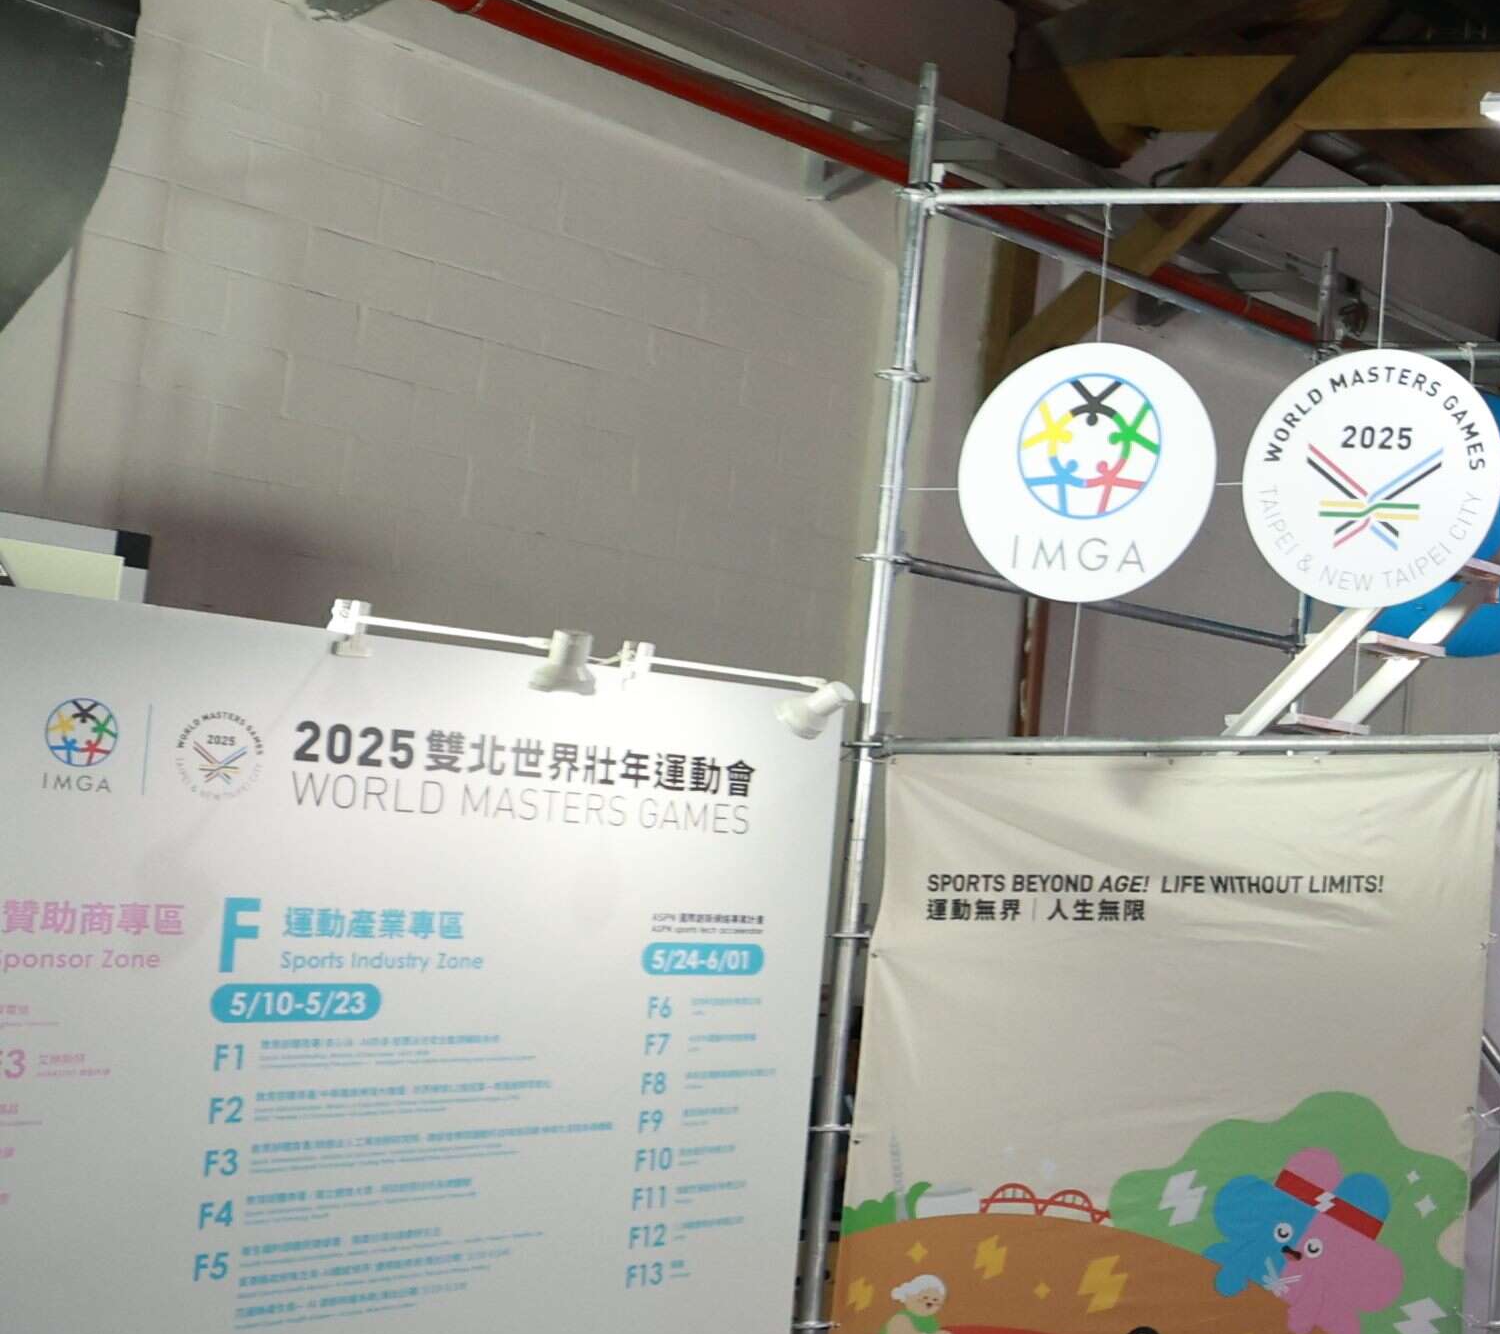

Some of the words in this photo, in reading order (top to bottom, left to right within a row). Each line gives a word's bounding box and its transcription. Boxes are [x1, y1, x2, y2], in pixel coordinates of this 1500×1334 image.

[1264, 387, 1324, 464] WORLD
[1329, 366, 1442, 399] MASTERS
[1442, 393, 1488, 472] GAMES
[1341, 425, 1413, 451] 2025
[1257, 484, 1297, 558] TAIPEI
[1318, 564, 1373, 592] NEW
[1380, 540, 1453, 591] TAIPEI
[1450, 491, 1481, 542] CITY
[1011, 536, 1147, 574] IMGA
[207, 734, 236, 746] 2025
[41, 772, 111, 793] IMGA
[291, 770, 445, 815] WORLD
[460, 783, 627, 828] MASTERS
[639, 797, 750, 835] GAMES
[927, 874, 1006, 893] SPORTS
[1012, 874, 1094, 893] BEYOND
[1098, 875, 1149, 893] AGE!
[1160, 875, 1205, 894] LIFE
[1210, 875, 1303, 894] WITHOUT
[1308, 875, 1385, 894] LIMITS!
[219, 897, 261, 973] F
[282, 907, 465, 940] 運動產業專區
[102, 950, 160, 969] Zone
[280, 952, 344, 971] Sports
[351, 953, 429, 974] Industry
[437, 953, 484, 970] Zone
[652, 949, 750, 972] 5/24-6/01
[229, 991, 367, 1020] 5/10-5/23
[648, 996, 672, 1019] F6
[213, 1044, 245, 1071] F1
[645, 1033, 671, 1056] F7
[0, 1049, 26, 1079] 3
[641, 1071, 667, 1095] F8
[208, 1097, 244, 1124] F2
[638, 1110, 664, 1133] F9
[203, 1149, 239, 1177] F3
[634, 1147, 672, 1172] F10
[632, 1186, 667, 1210] F11
[198, 1200, 234, 1230] F4
[629, 1224, 667, 1249] F12
[193, 1252, 229, 1282] F5
[626, 1262, 663, 1289] F13
